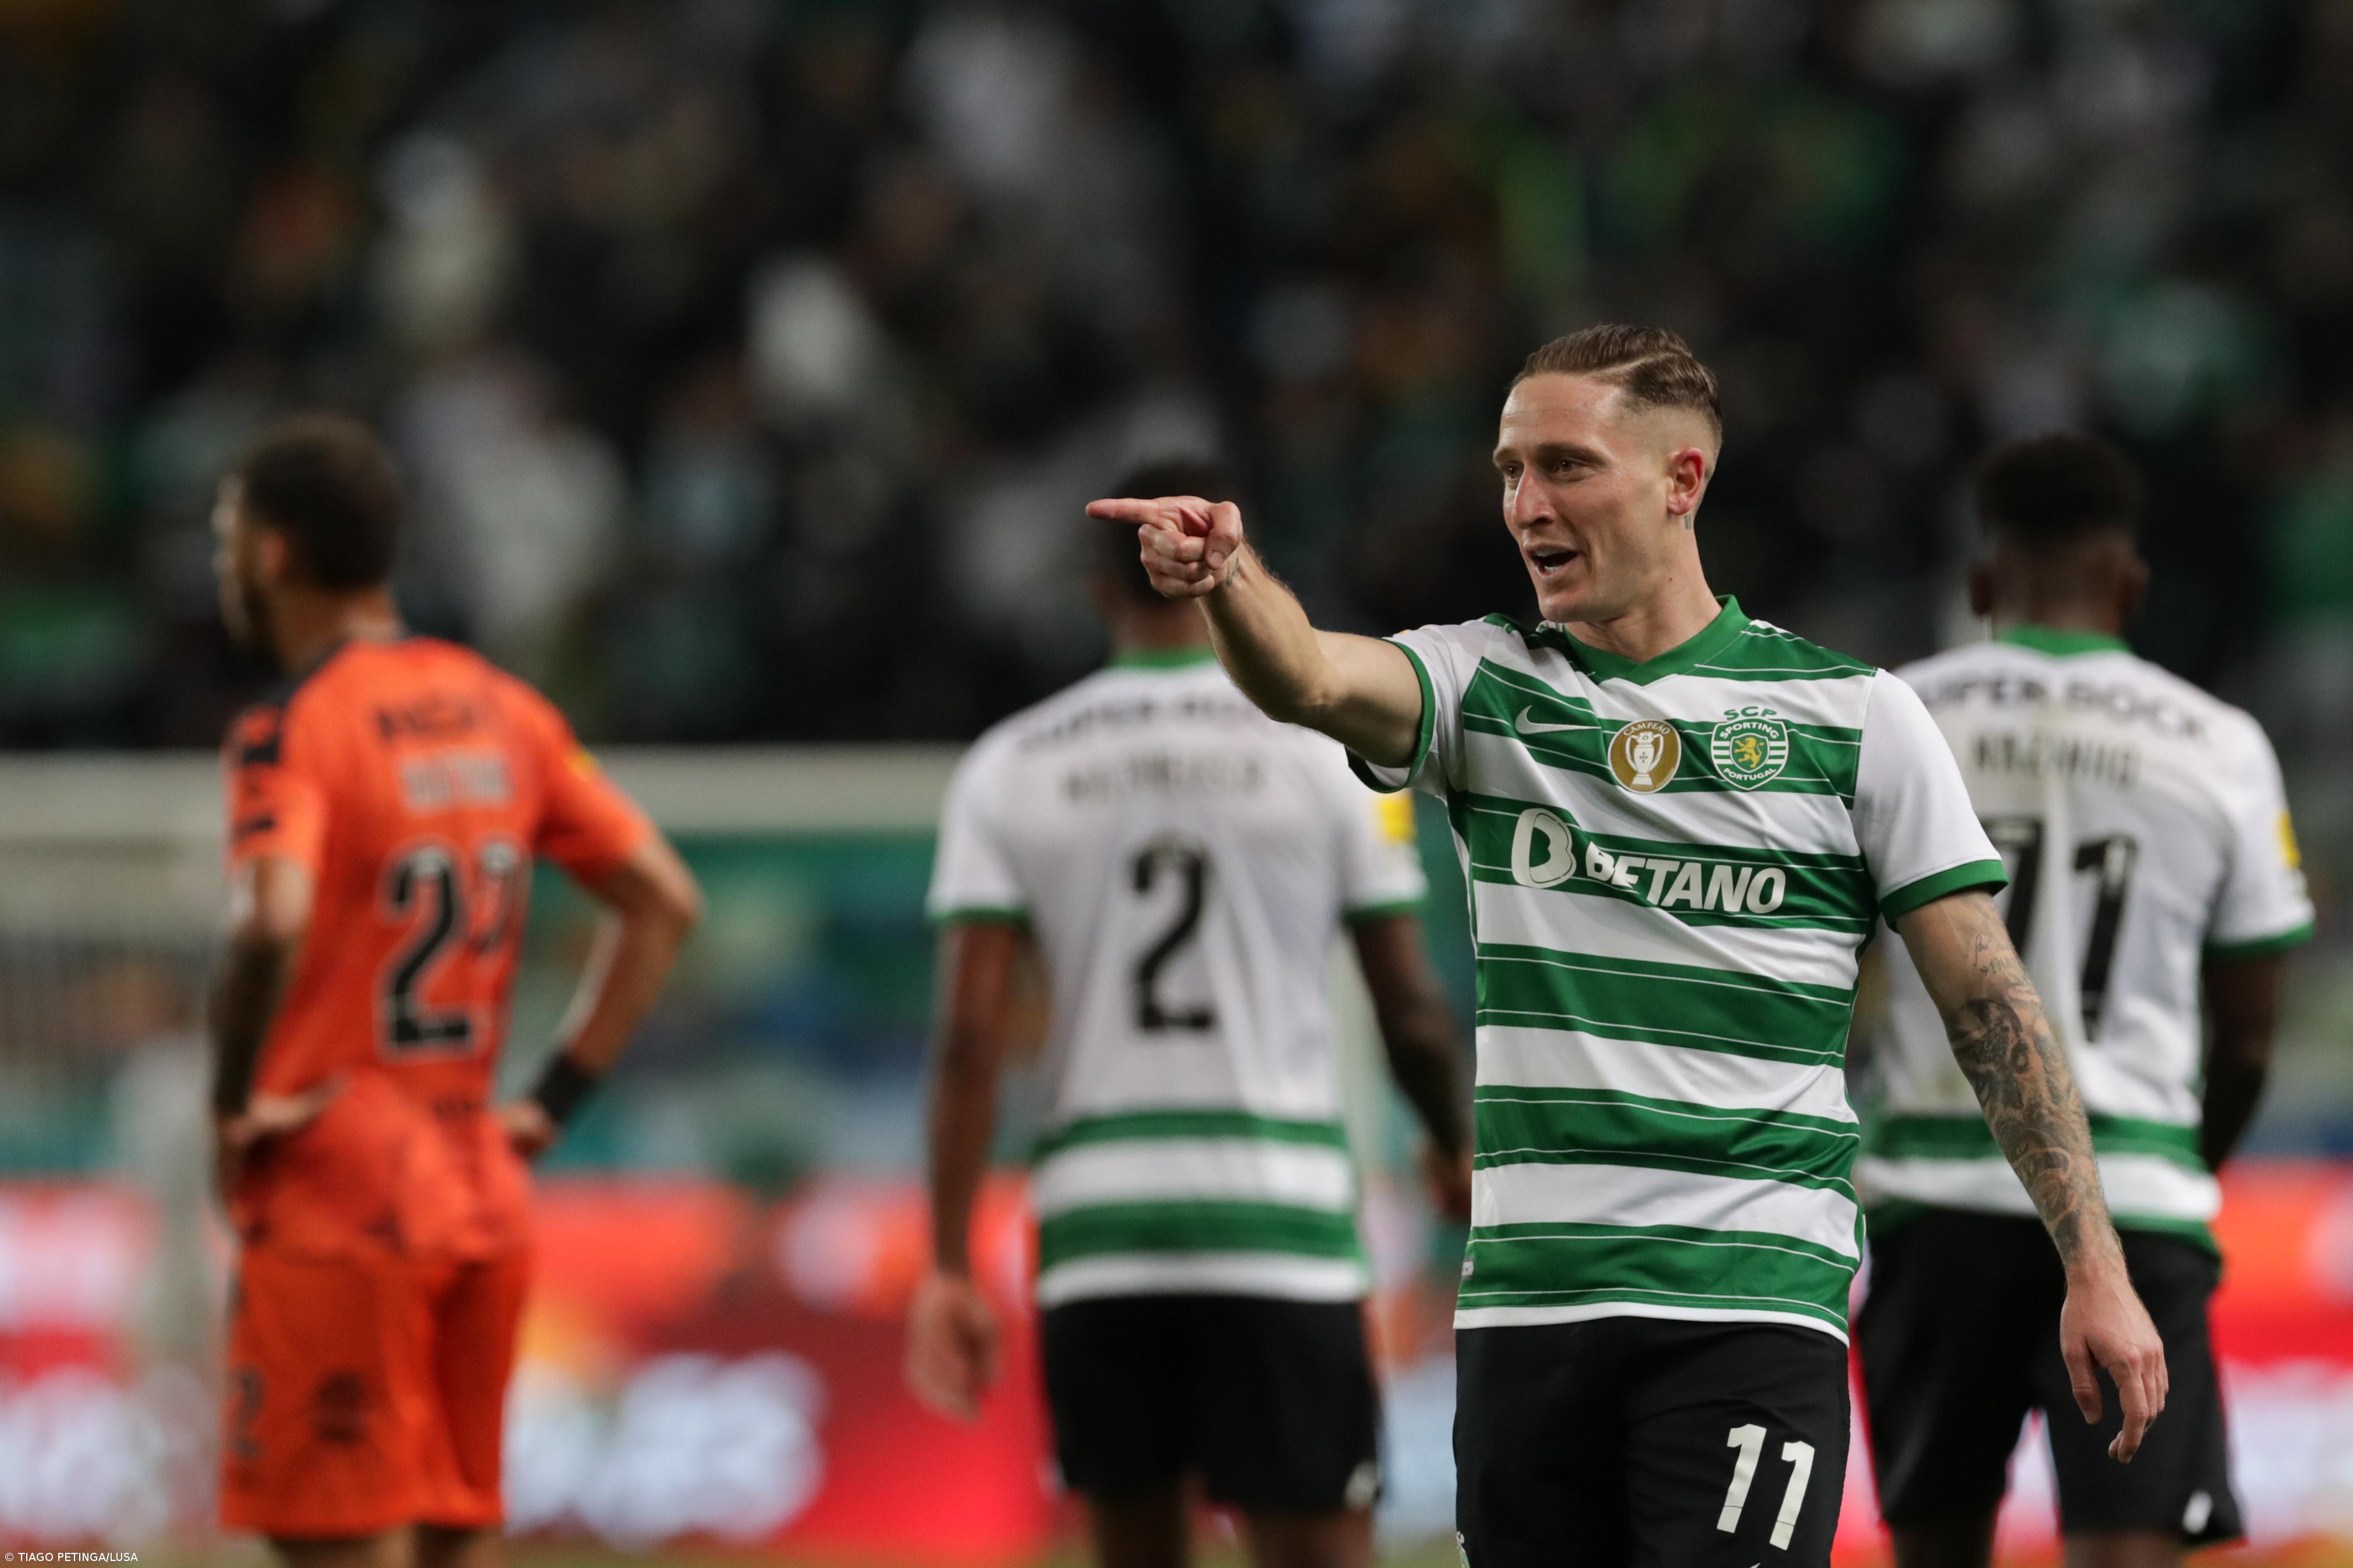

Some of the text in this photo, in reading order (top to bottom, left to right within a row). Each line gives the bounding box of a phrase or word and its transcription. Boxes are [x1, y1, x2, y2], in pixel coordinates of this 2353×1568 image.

[1719, 721, 1780, 739] SPORTING
[1723, 706, 1777, 721] SCP
[1723, 767, 1777, 781] PORTUGAL
[1585, 840, 1786, 914] BETANO
[1128, 832, 1218, 1033] 2
[1717, 1423, 1815, 1551] 11
